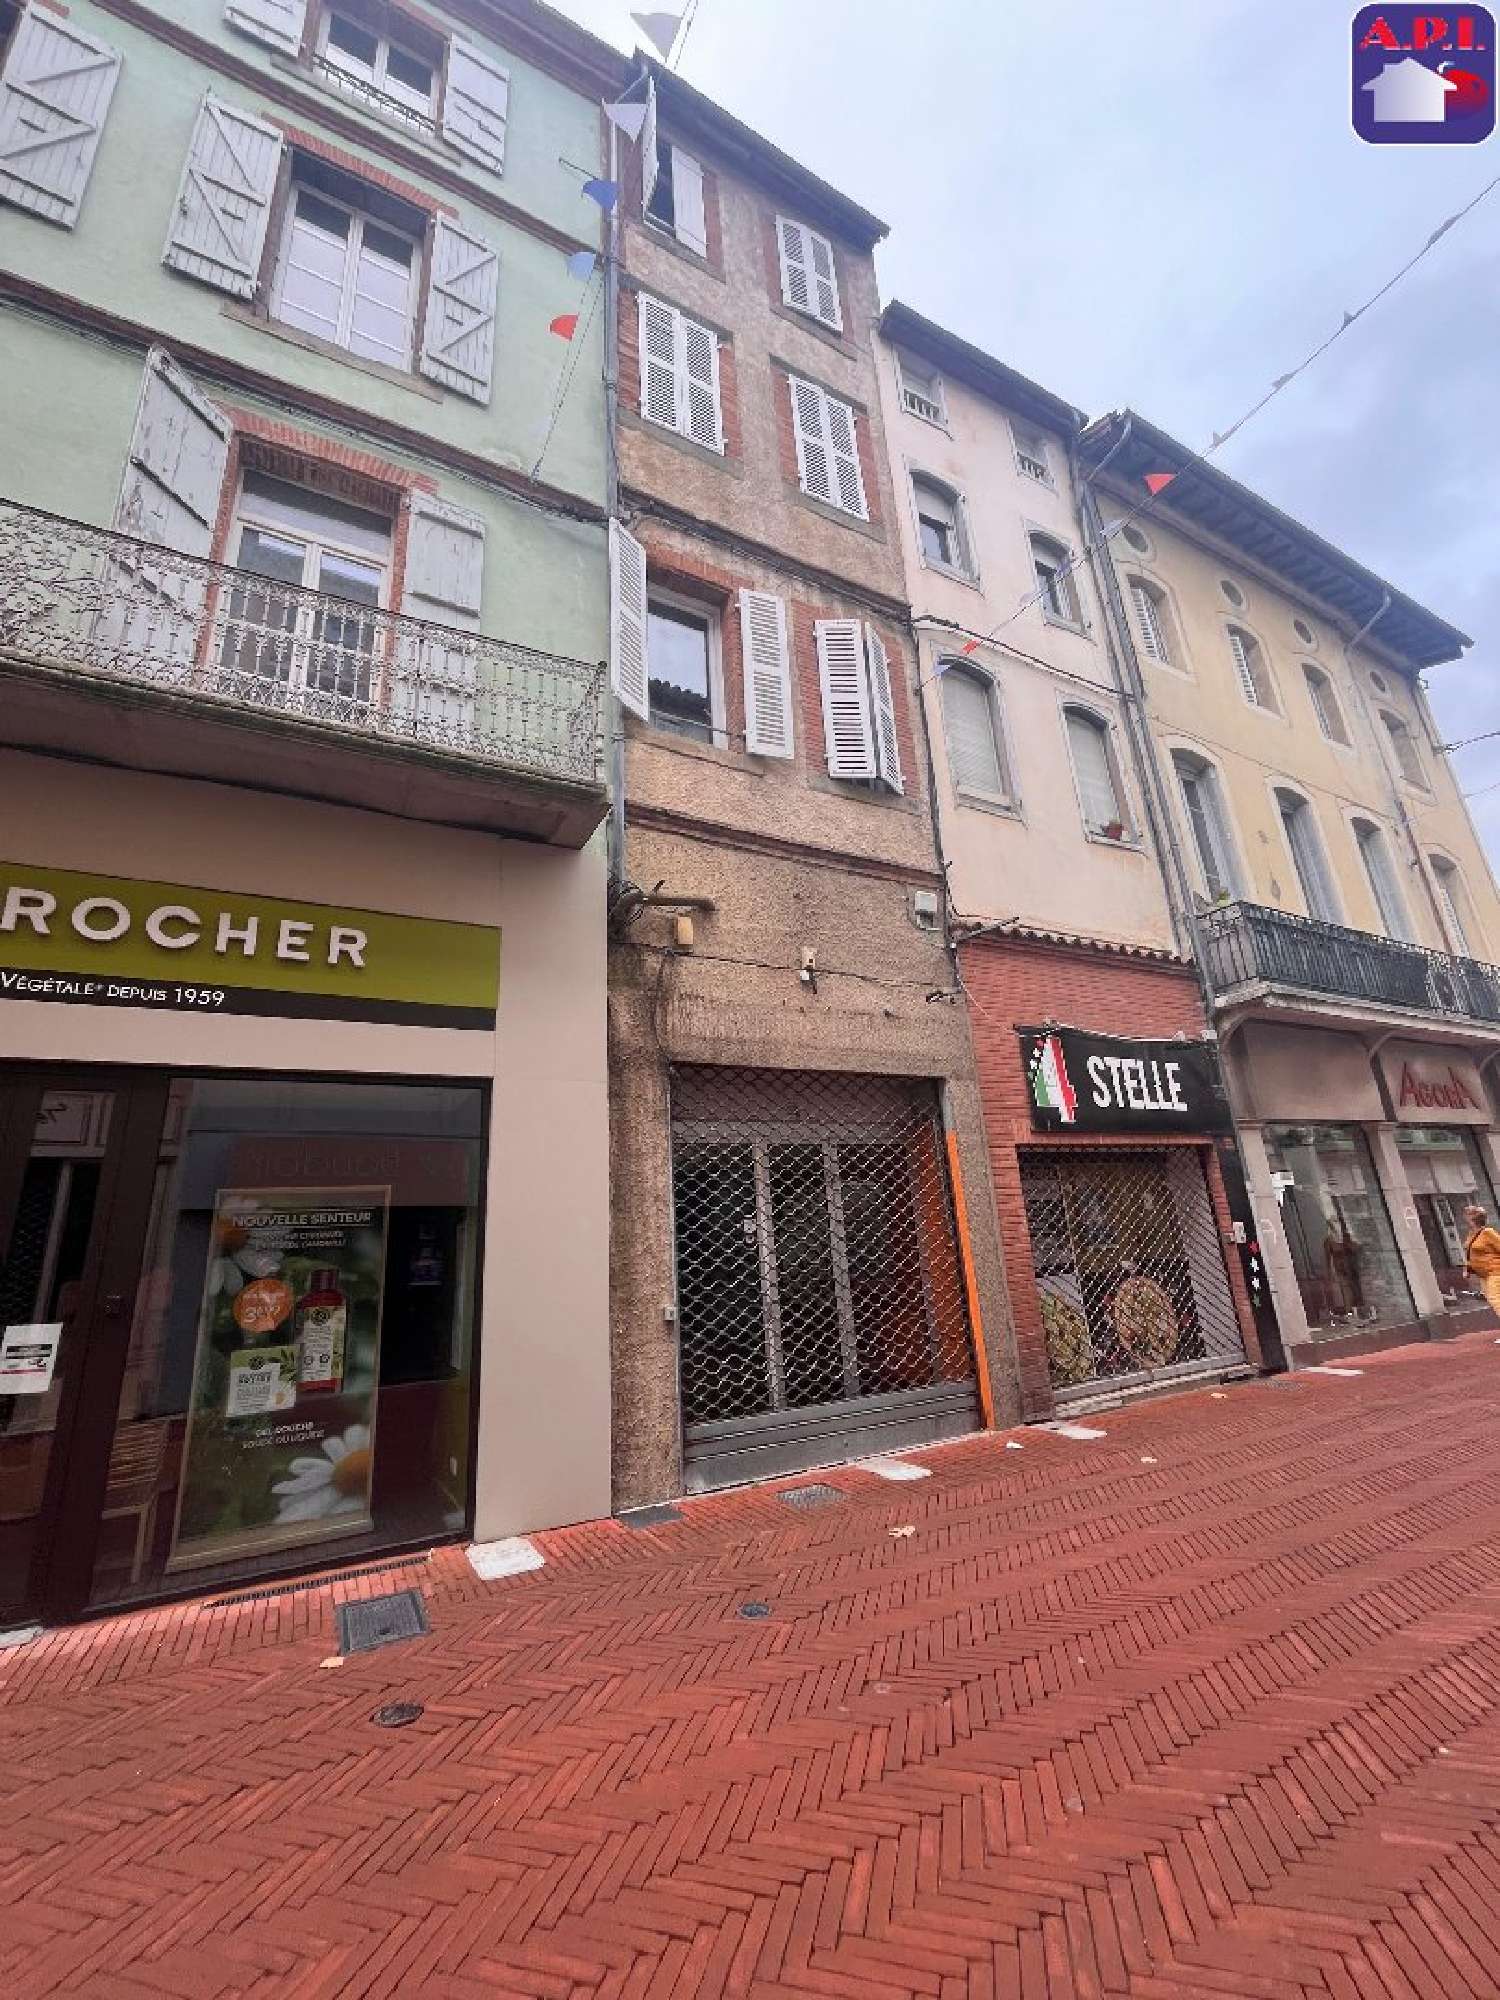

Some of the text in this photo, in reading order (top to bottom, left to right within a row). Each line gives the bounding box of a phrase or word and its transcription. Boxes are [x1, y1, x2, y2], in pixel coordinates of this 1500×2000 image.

[0, 886, 369, 968] ROCHER
[106, 984, 167, 1001] DEPUIS
[175, 988, 225, 1007] 1959
[1086, 1055, 1188, 1112] STELLE
